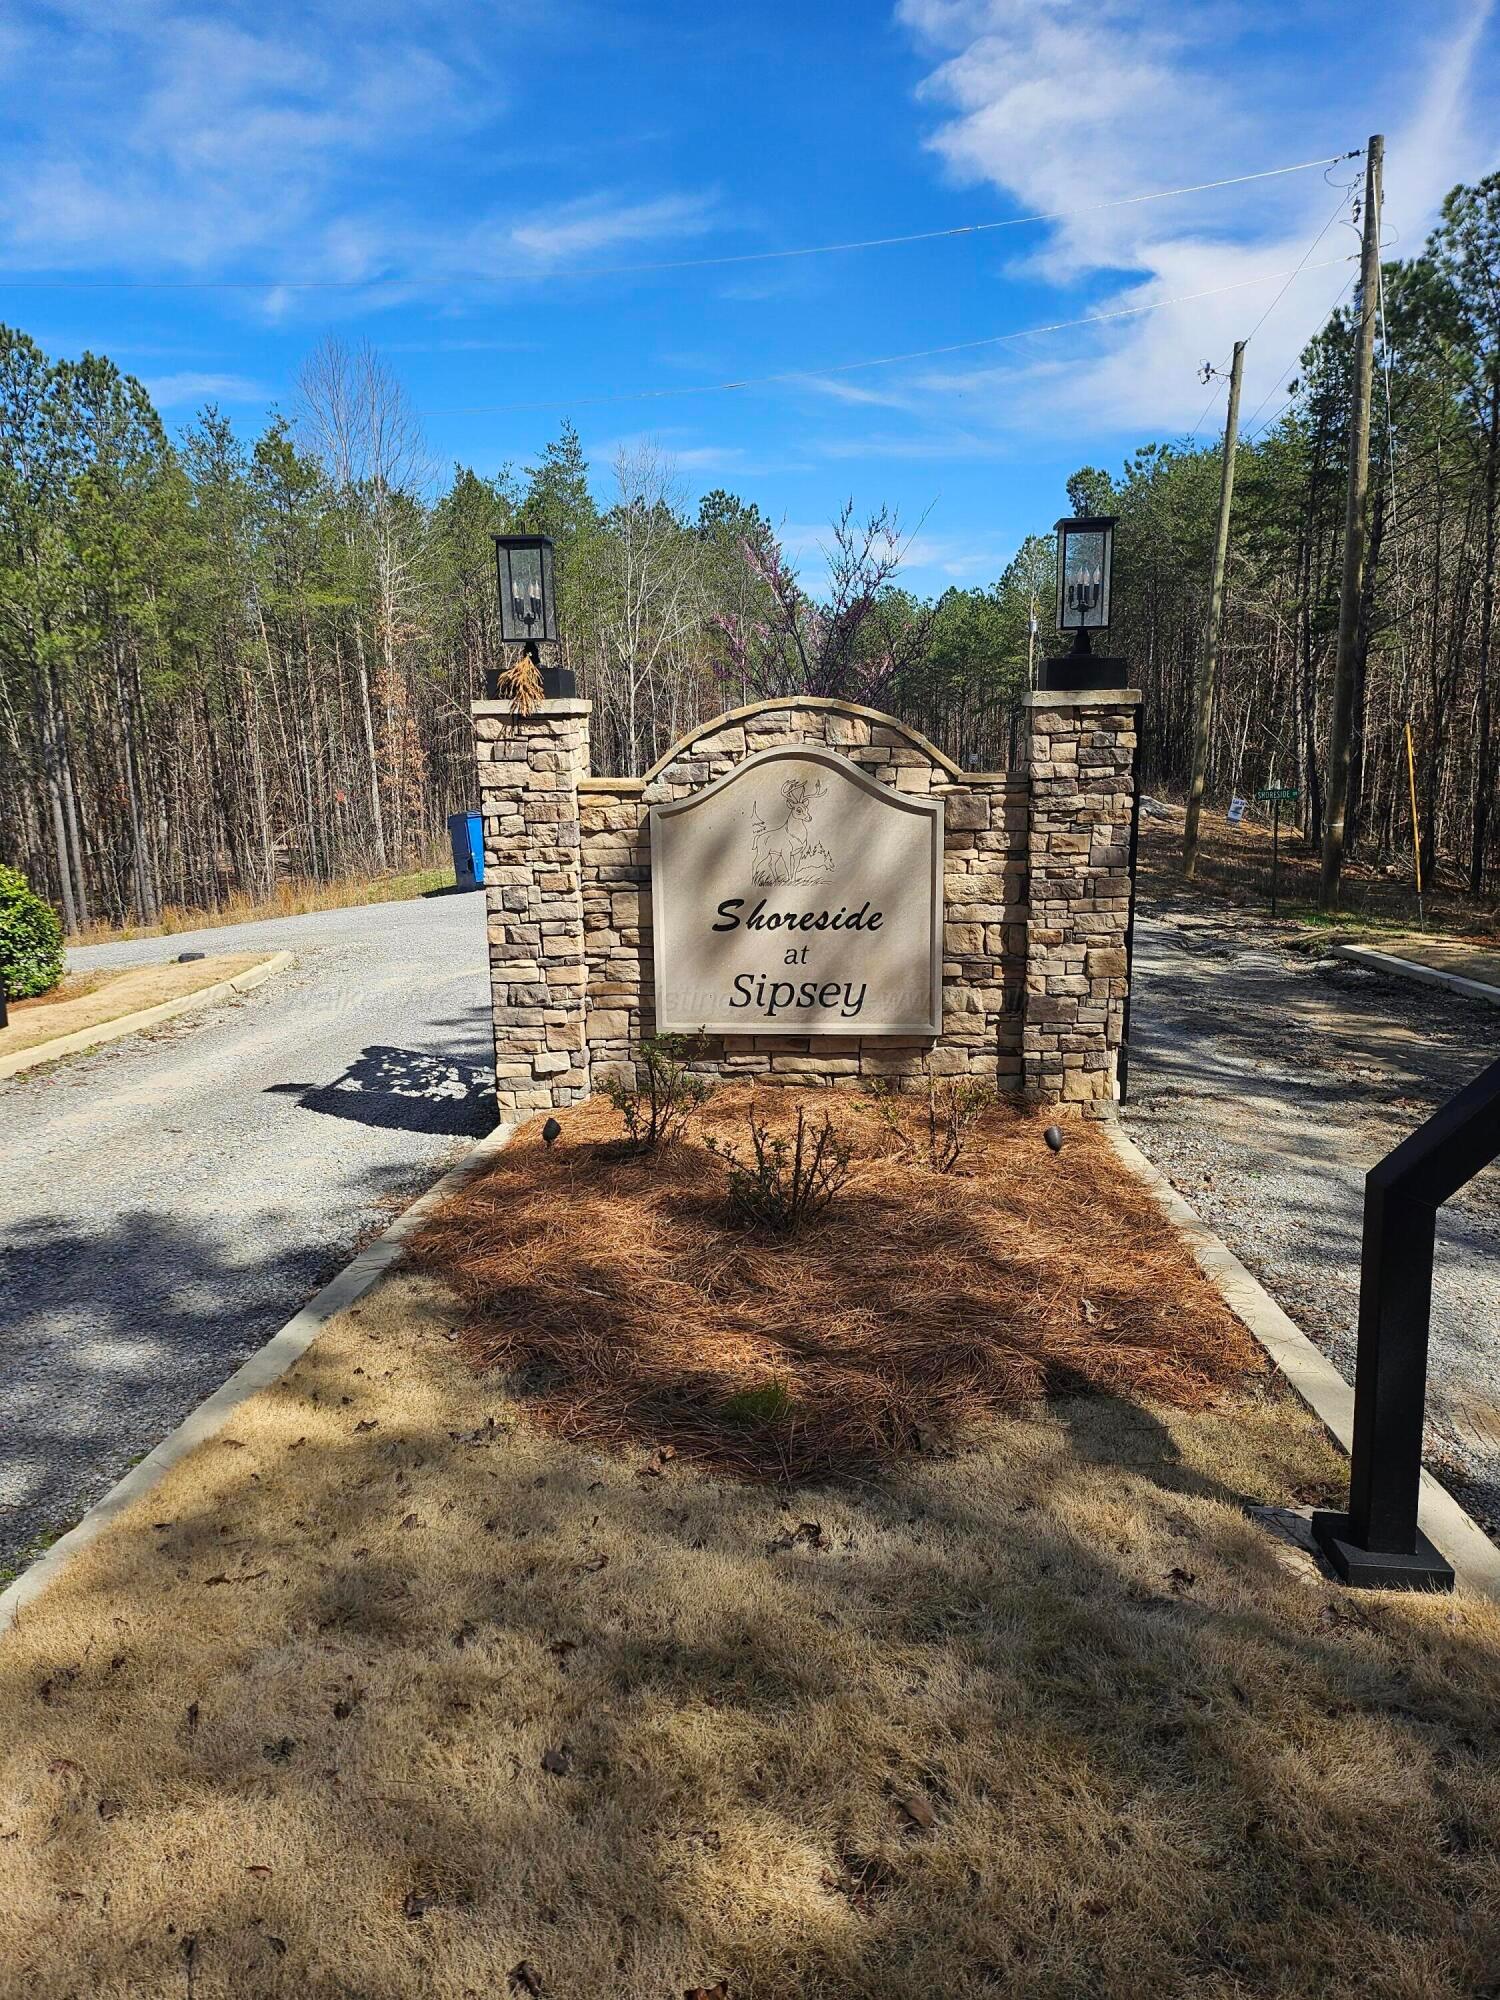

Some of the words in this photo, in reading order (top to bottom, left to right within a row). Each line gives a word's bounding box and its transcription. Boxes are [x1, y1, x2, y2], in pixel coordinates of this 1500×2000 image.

[1257, 790, 1290, 800] SHORESIDE
[711, 898, 884, 933] Shoreside
[783, 945, 810, 965] at
[728, 973, 867, 1018] Sipsey
